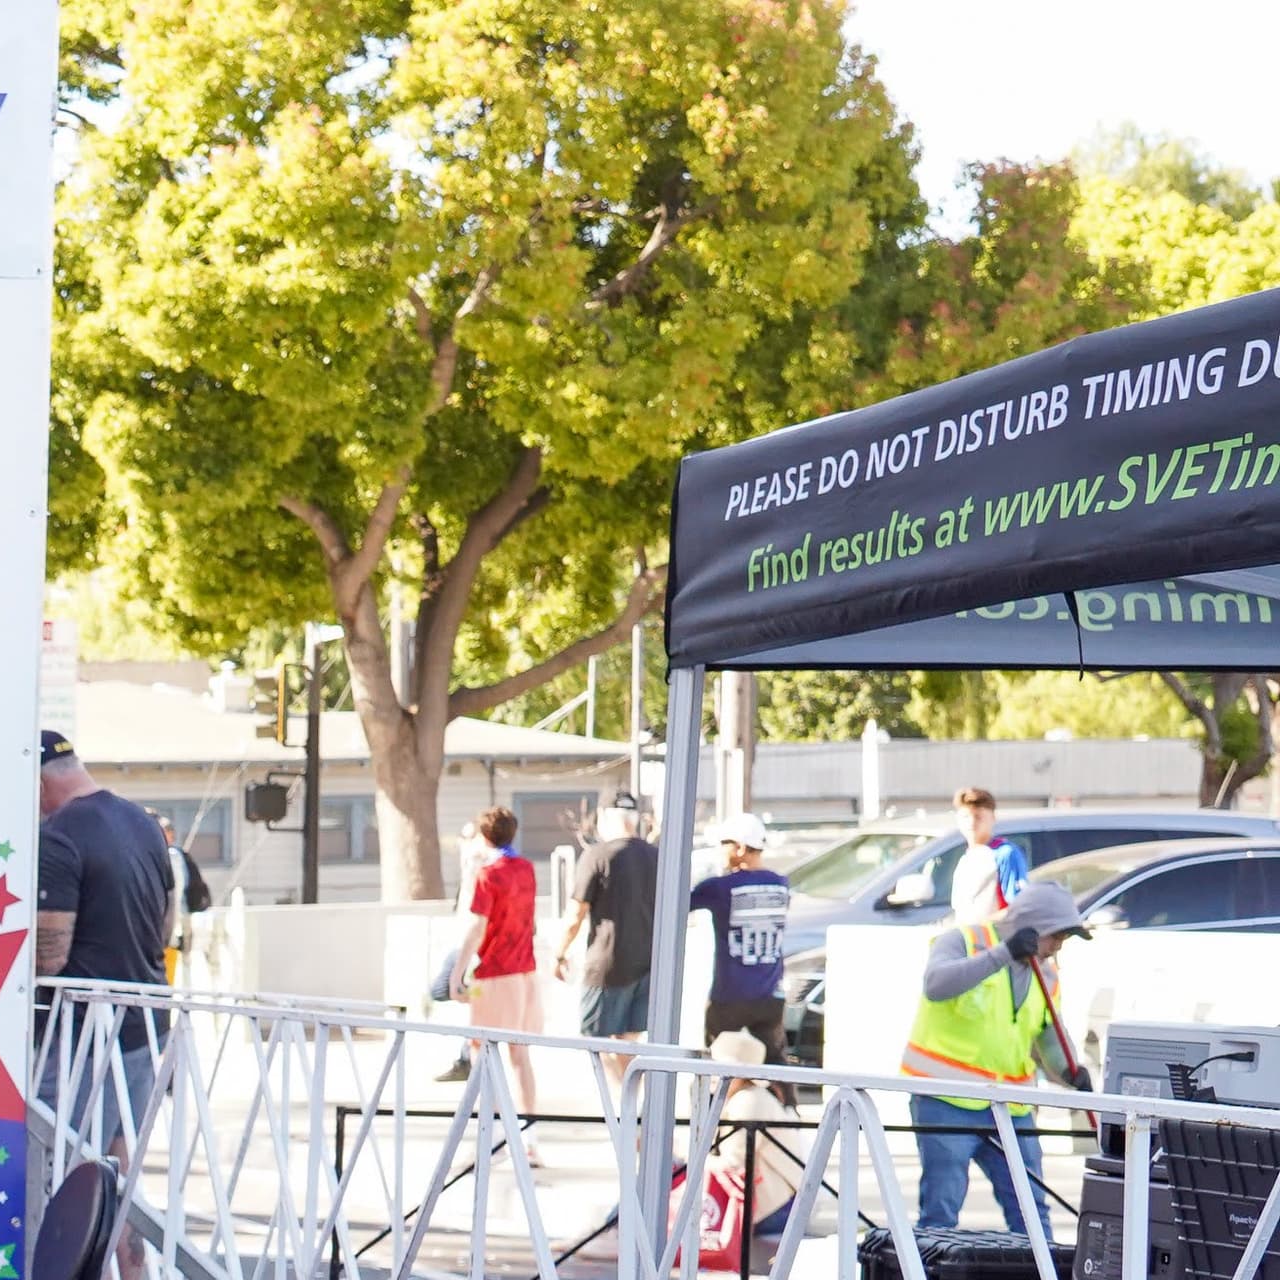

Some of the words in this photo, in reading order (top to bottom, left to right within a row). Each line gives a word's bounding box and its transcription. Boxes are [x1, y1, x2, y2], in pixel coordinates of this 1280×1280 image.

[725, 456, 812, 521] PLEASE
[818, 449, 860, 497] DO
[865, 426, 930, 482] NOT
[934, 384, 1070, 463] DISTURB
[1081, 347, 1227, 421] TIMING
[747, 533, 809, 593] Find
[818, 510, 925, 578] results
[934, 497, 973, 549] at
